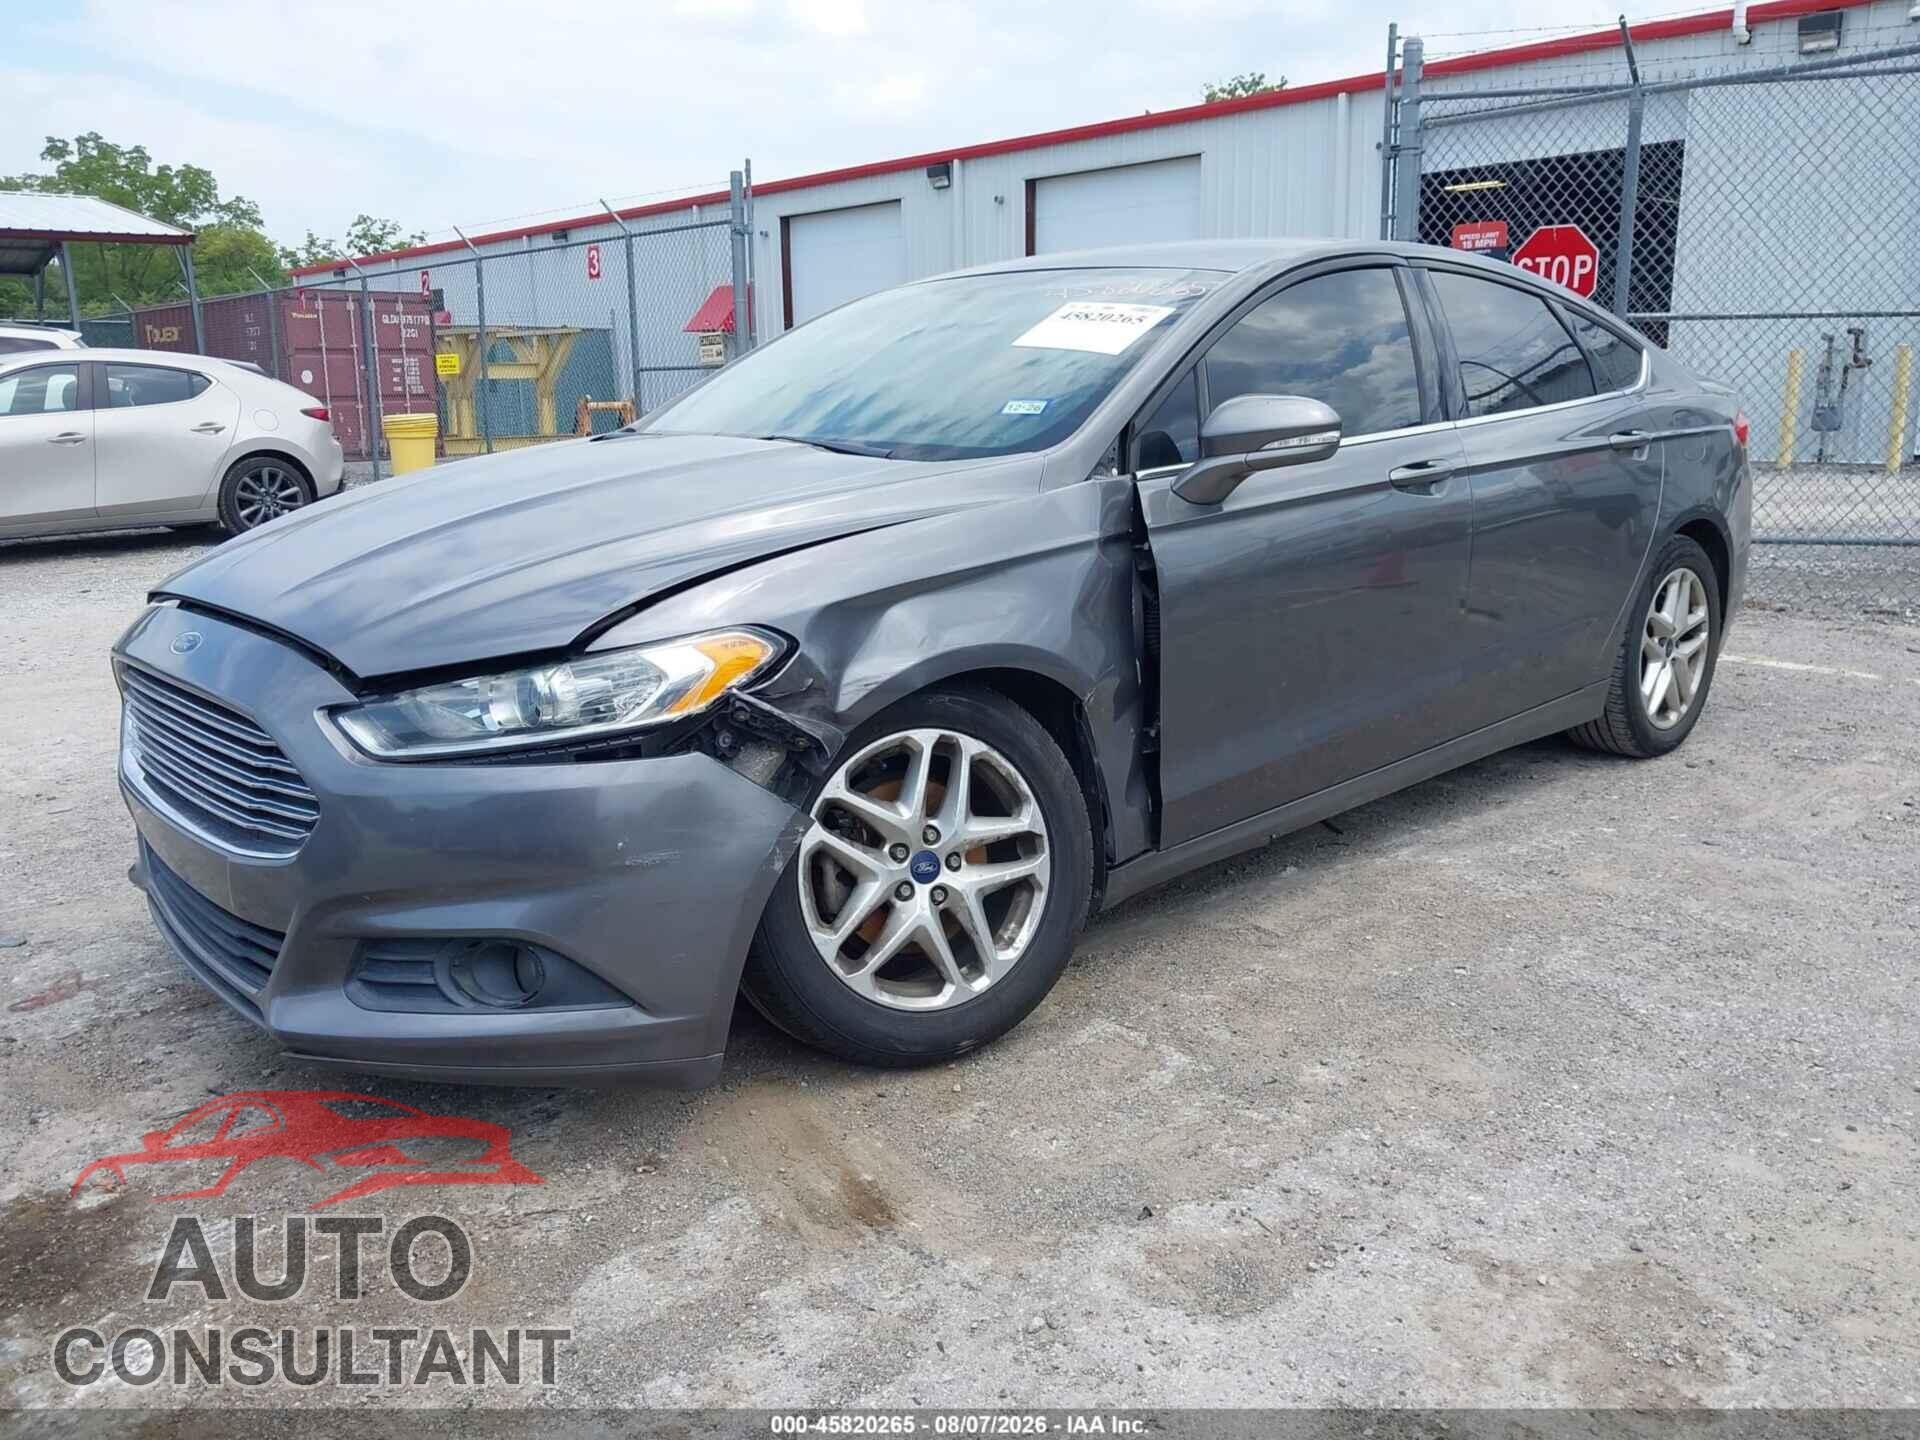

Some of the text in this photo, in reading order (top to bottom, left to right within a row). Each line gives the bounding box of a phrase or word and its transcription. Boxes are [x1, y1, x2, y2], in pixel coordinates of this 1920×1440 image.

[1462, 238, 1497, 249] 15 MPH
[589, 250, 599, 275] 3
[1518, 254, 1593, 289] TOP
[421, 275, 430, 295] 2
